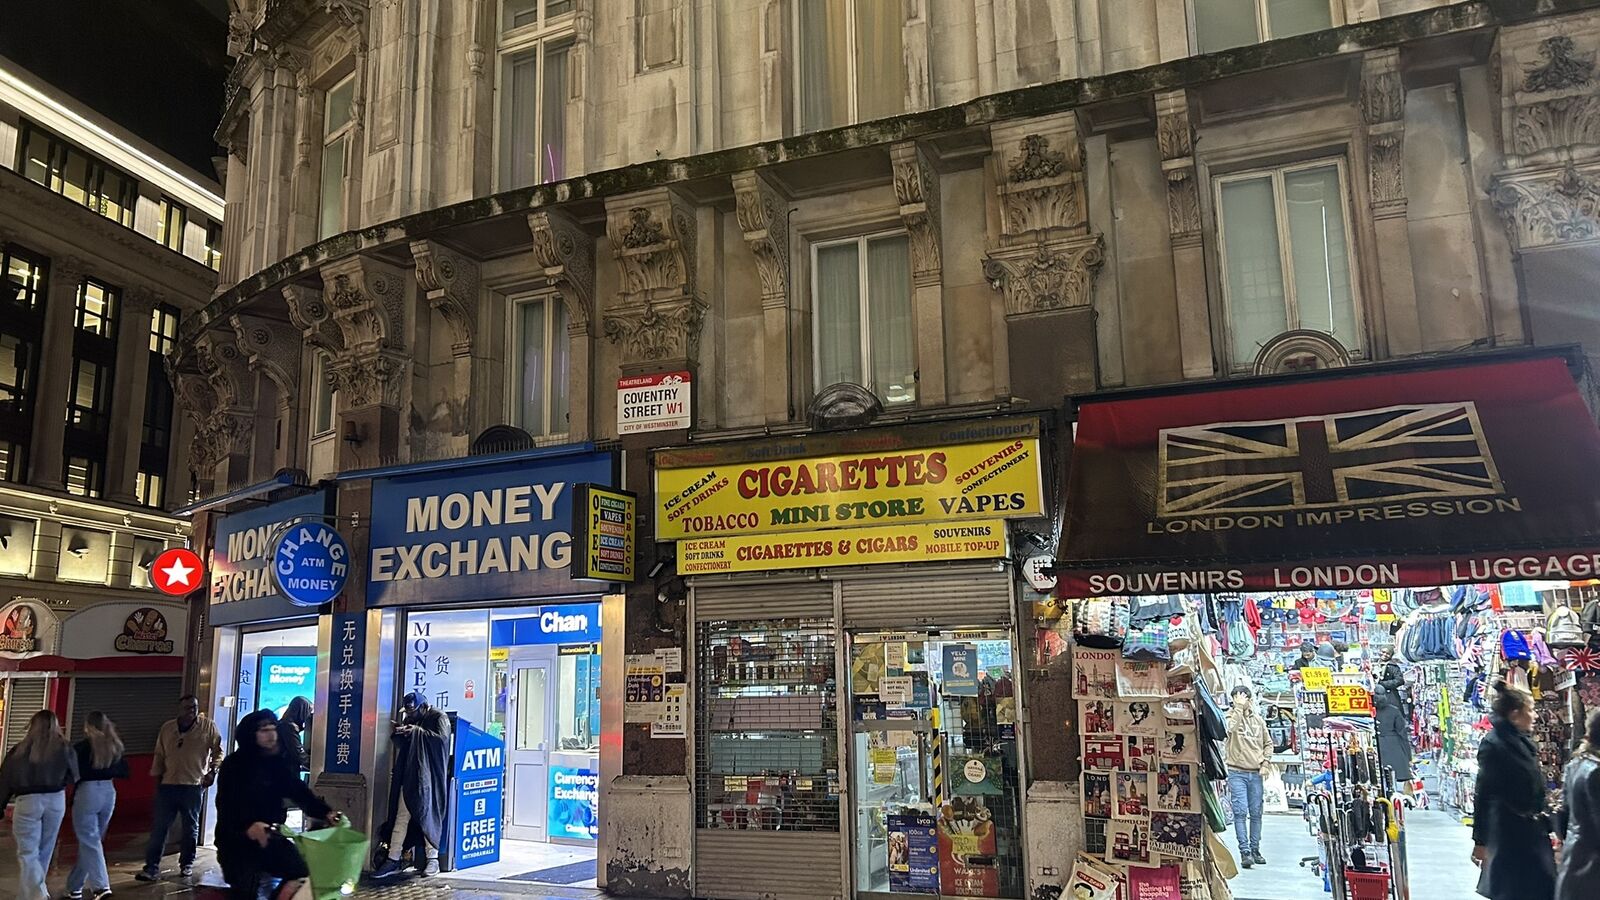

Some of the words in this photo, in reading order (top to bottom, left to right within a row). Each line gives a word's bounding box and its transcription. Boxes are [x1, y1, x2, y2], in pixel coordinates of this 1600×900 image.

[620, 377, 653, 387] THEATRELAND
[624, 388, 679, 405] COVENTRY
[624, 404, 663, 419] STREET
[666, 402, 683, 415] W1
[643, 420, 679, 429] WESTMINSTER
[939, 423, 1034, 441] Confectionery
[955, 440, 1024, 485] SOUVENIRS
[961, 450, 1030, 494] CONFECTIONERY
[737, 451, 948, 500] CIGARETTES
[664, 495, 681, 510] ICE
[682, 471, 717, 498] CREAM
[667, 502, 691, 522] SOFT
[692, 477, 729, 506] DRINKS
[405, 482, 566, 534] MONEY
[770, 504, 831, 526] MINI
[835, 497, 925, 521] STORE
[939, 492, 1026, 515] VAPES
[603, 511, 622, 522] VAPES
[682, 512, 759, 533] TOBACCO
[1147, 514, 1284, 535] LONDON
[1296, 497, 1522, 527] IMPRESSION
[591, 494, 600, 572] OPEN
[600, 536, 609, 546] ICE
[608, 537, 625, 548] CREAM
[625, 501, 633, 575] TOBACCO
[933, 526, 991, 539] SOUVENIRS
[279, 528, 347, 578] CHANGE
[685, 542, 698, 551] ICE
[699, 540, 726, 550] CREAM
[736, 541, 833, 562] CIGARETTES
[838, 540, 851, 555] &
[856, 535, 919, 554] CIGARS
[925, 544, 961, 555] MOBILE
[964, 540, 1000, 552] TOP-UP
[301, 557, 325, 568] ATM
[370, 531, 572, 583] EXCHANG
[685, 552, 700, 561] SOFT
[701, 551, 724, 560] DRINKS
[685, 561, 732, 572] CONFECTIONERY
[1273, 563, 1400, 589] LONDON
[1450, 554, 1600, 583] LUGGAG
[288, 577, 338, 591] MONEY
[1088, 569, 1245, 595] SOUVENIRS
[269, 674, 305, 685] Money
[270, 665, 310, 676] Change
[336, 620, 356, 764] 无兑换手续费
[434, 655, 450, 710] 货币
[1330, 688, 1366, 697] £3.99
[1331, 701, 1338, 709] 2
[1352, 699, 1366, 708] £7
[462, 747, 501, 772] ATM
[463, 818, 496, 837] FREE
[462, 833, 495, 852] CASH
[1163, 842, 1200, 855] DIRECTION
[462, 848, 494, 860] WITHDRAWALS
